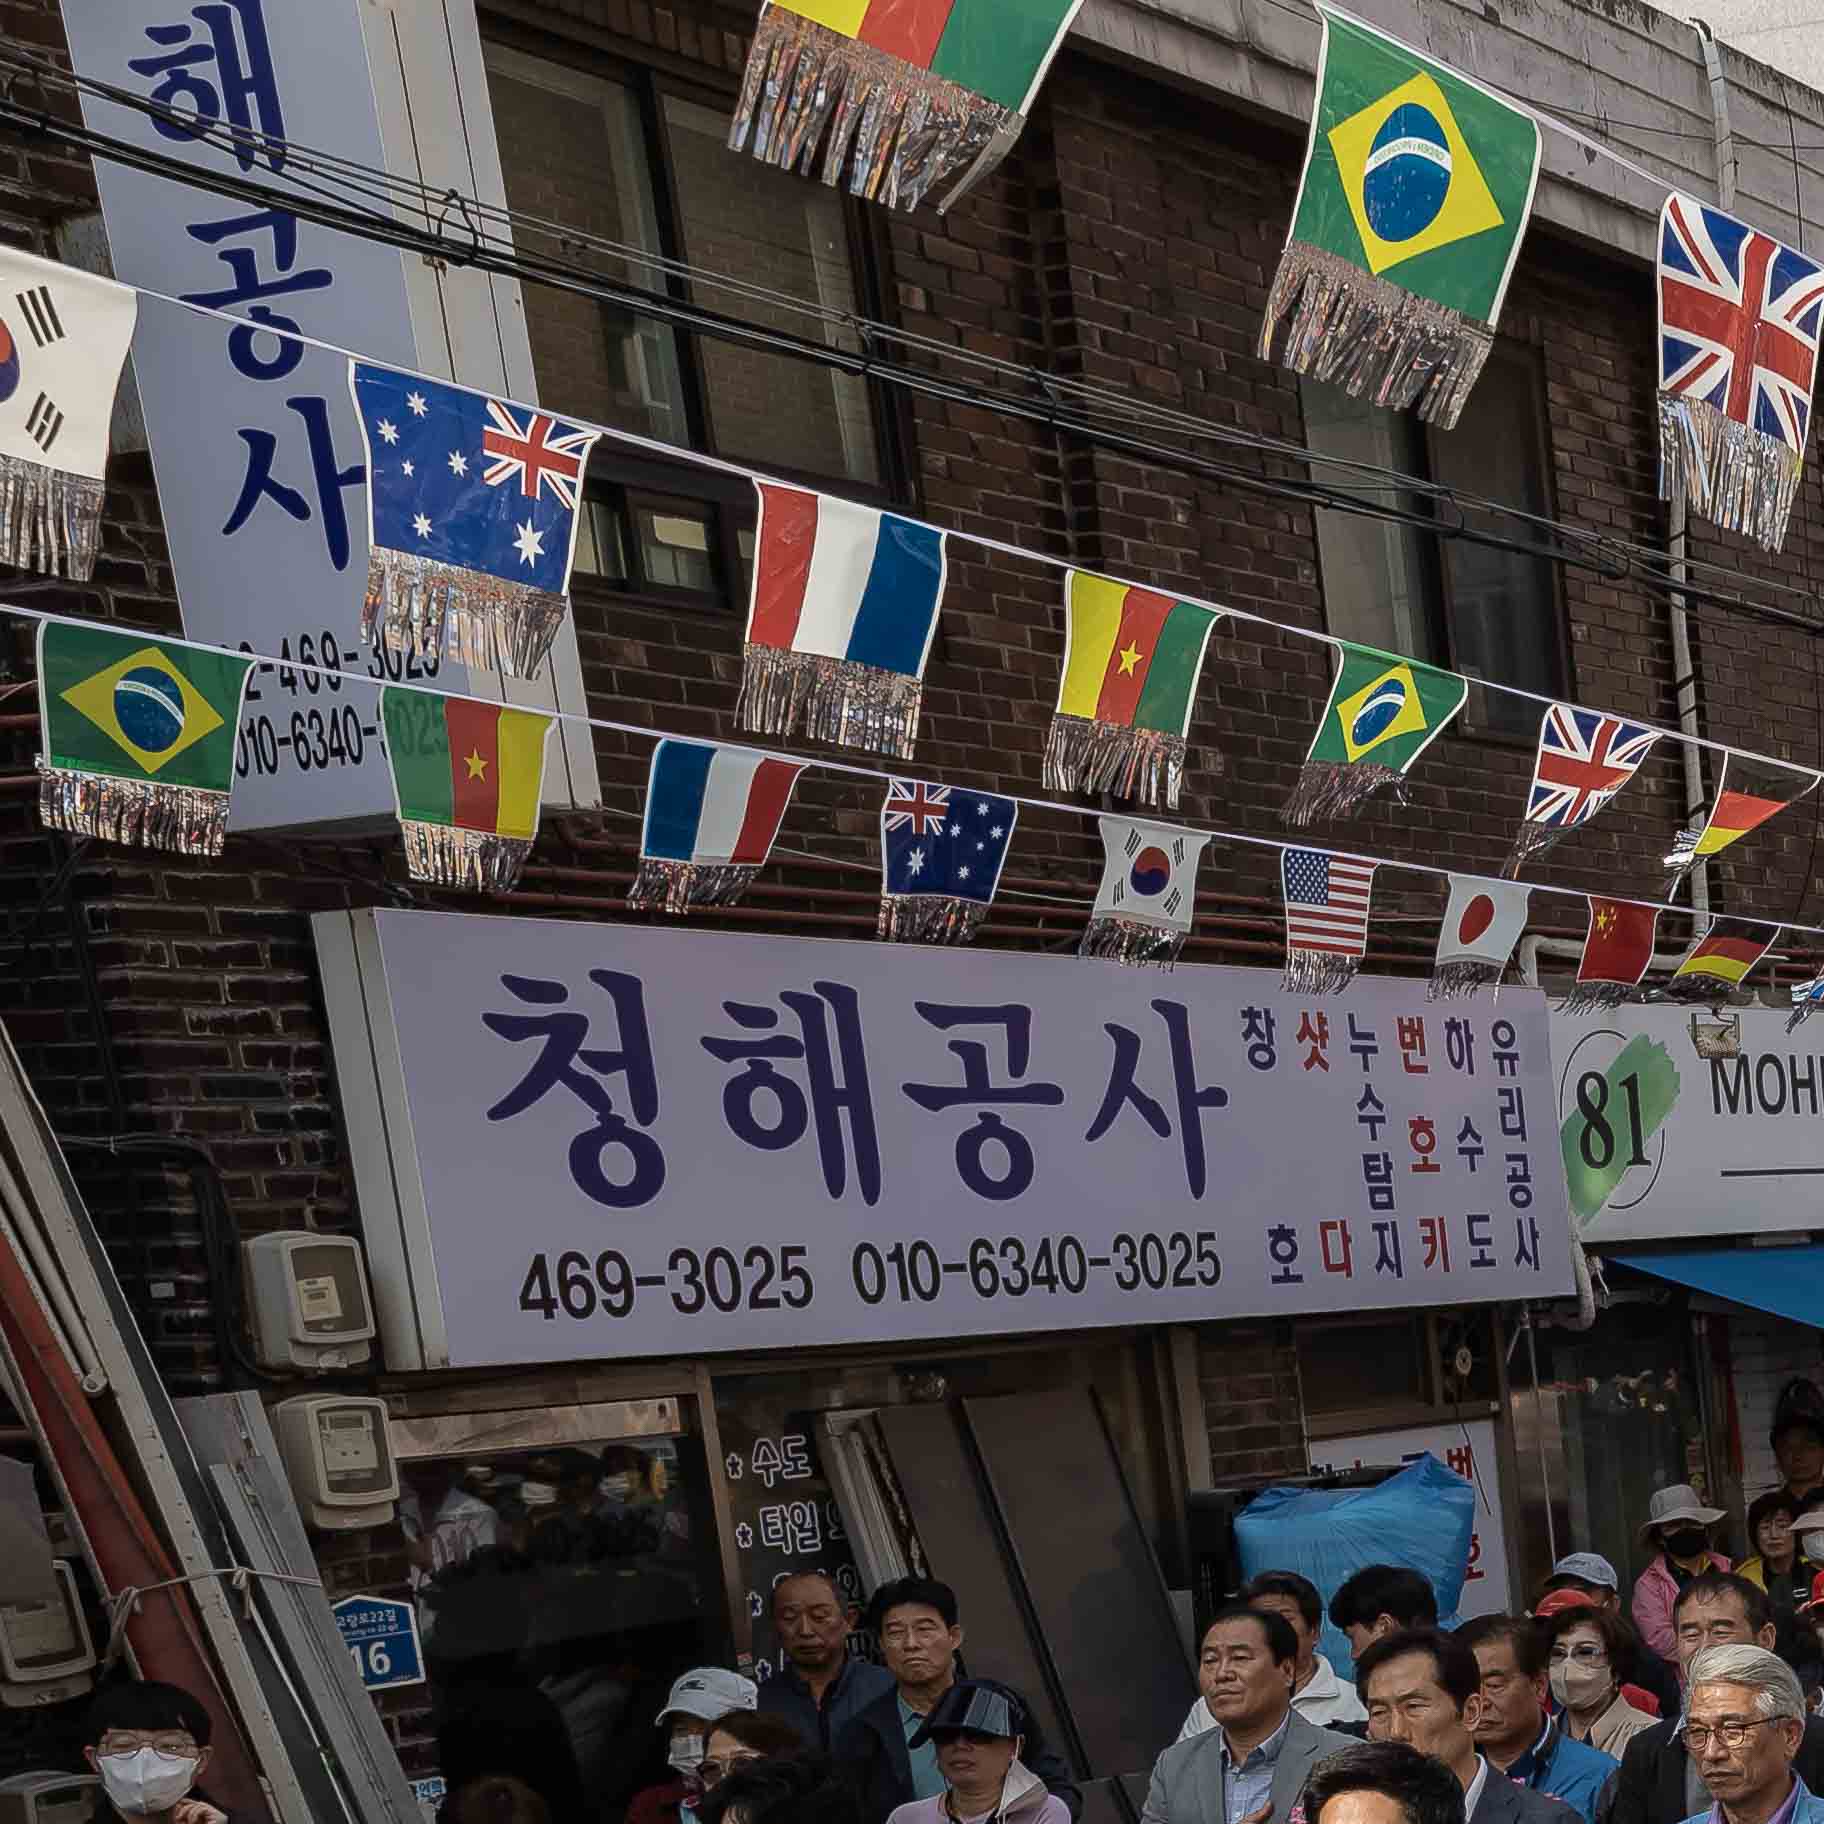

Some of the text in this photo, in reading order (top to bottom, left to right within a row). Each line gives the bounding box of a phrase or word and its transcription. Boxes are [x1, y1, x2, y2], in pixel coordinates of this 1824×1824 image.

[482, 966, 1229, 1209] 청해공사
[1575, 1069, 1653, 1171] 81
[1347, 1012, 1403, 1279] 누수탐지
[1491, 1019, 1540, 1272] 유리공사
[518, 1230, 1223, 1322] 469-3025 010-6340-3025
[752, 1435, 812, 1488] 수도
[759, 1501, 823, 1556] 타일
[350, 1641, 392, 1678] 16
